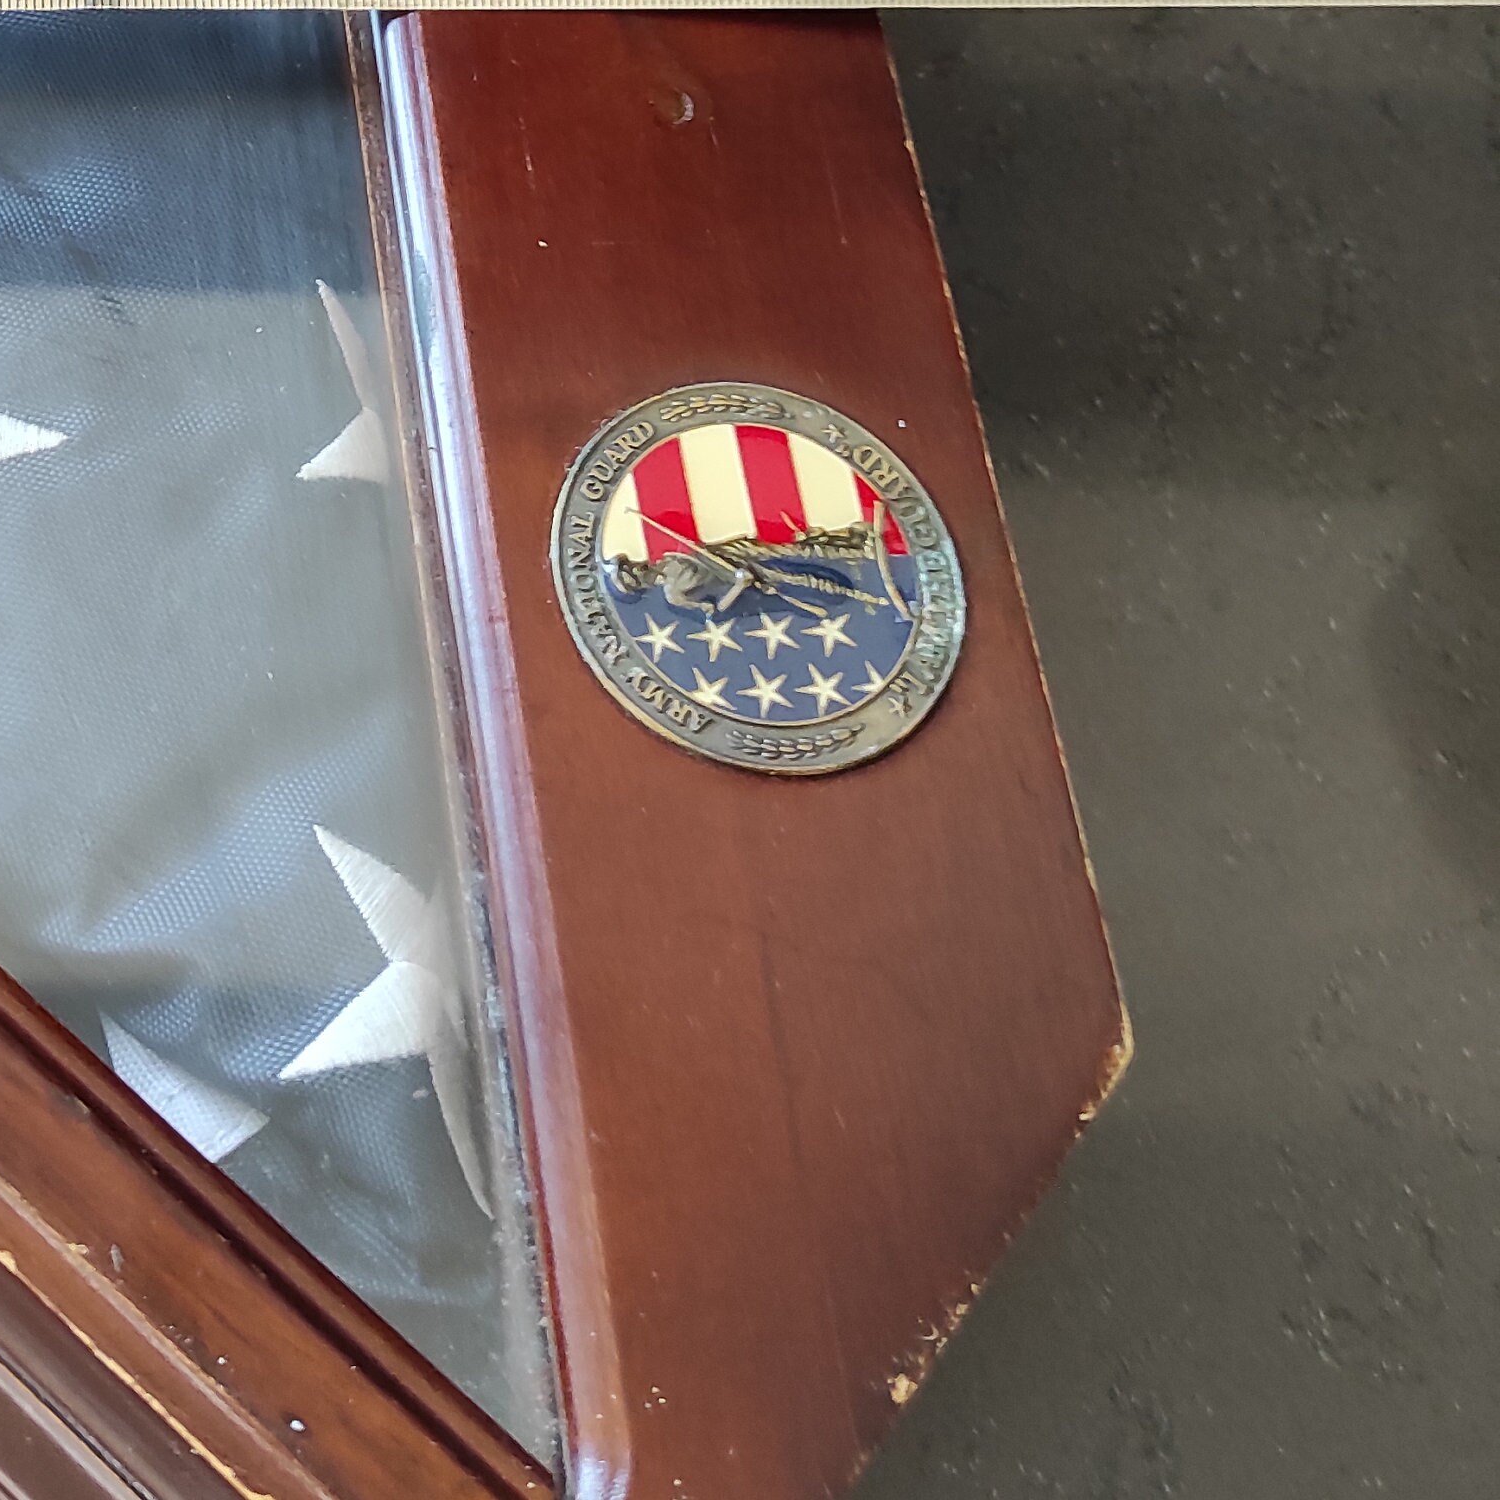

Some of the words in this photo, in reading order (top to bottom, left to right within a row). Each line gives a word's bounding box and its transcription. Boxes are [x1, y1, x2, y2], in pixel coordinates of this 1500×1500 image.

[580, 420, 656, 501] GUARD
[567, 513, 630, 665] NATIONAL
[626, 667, 716, 734] ARMY
